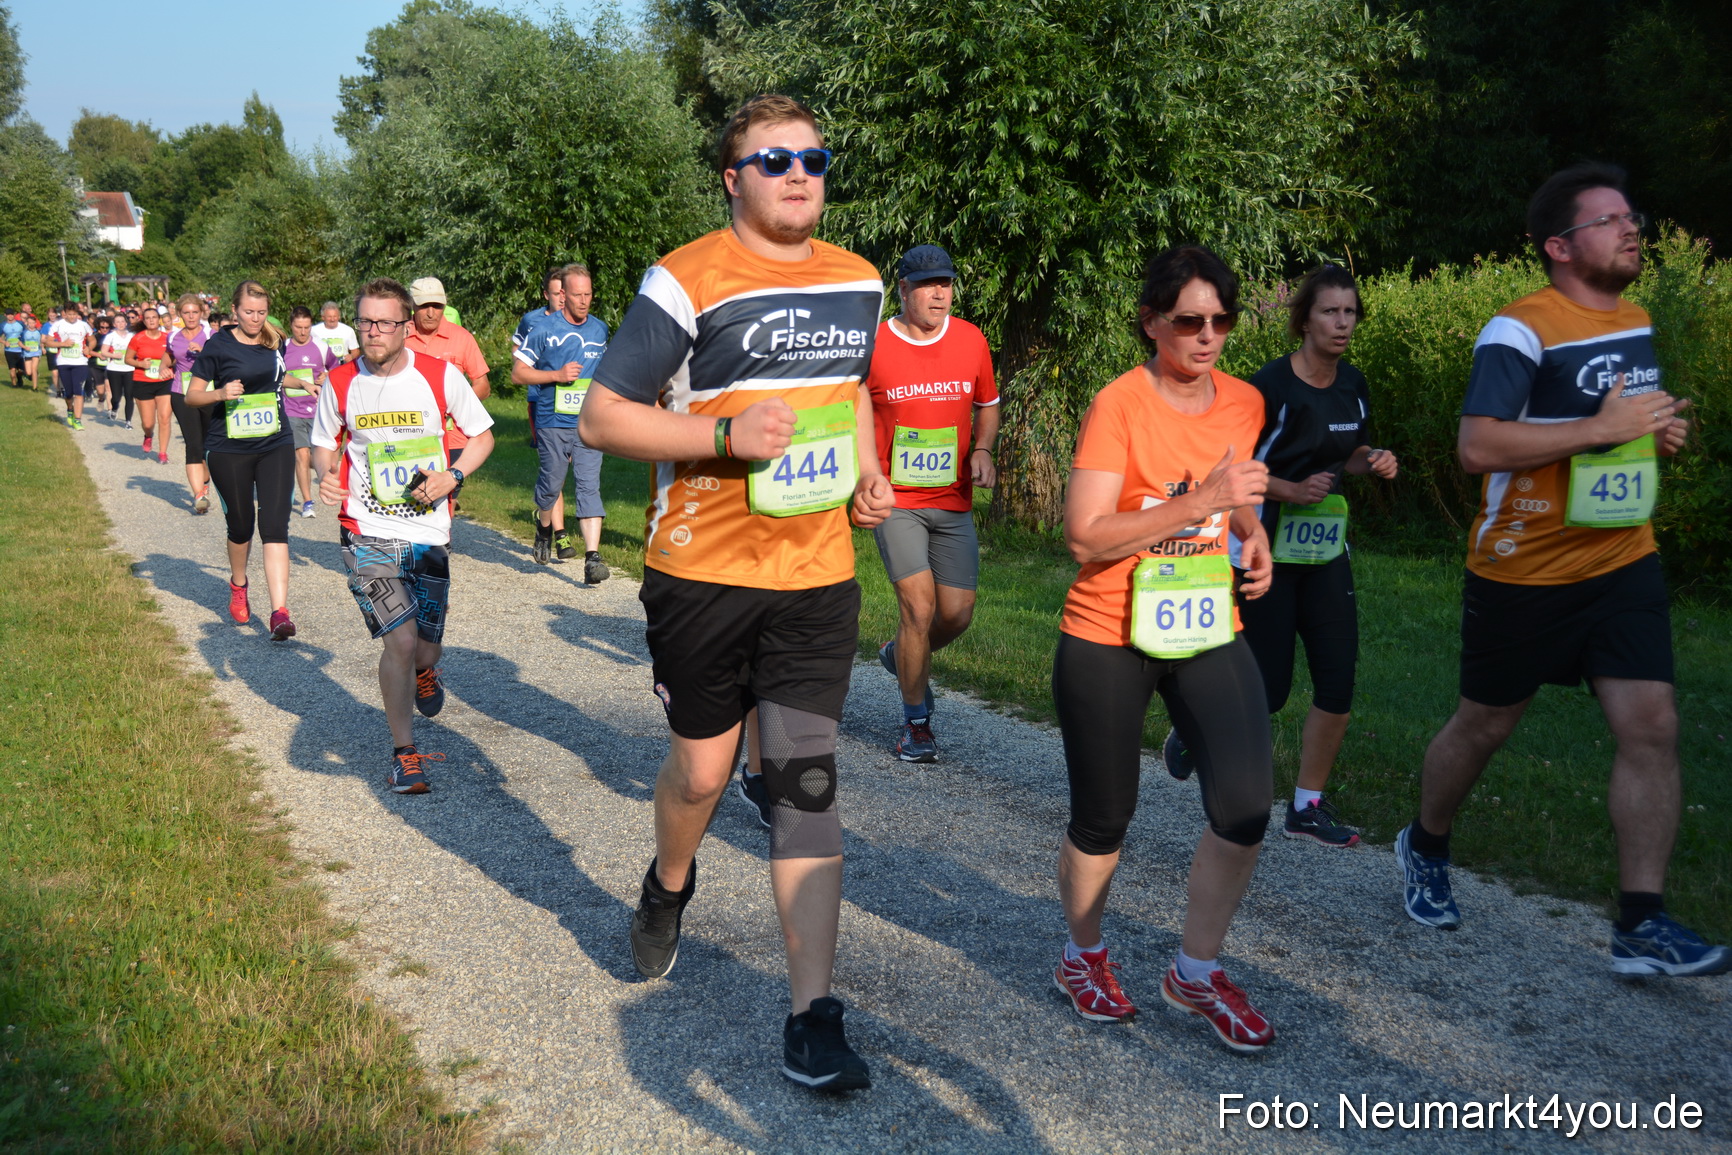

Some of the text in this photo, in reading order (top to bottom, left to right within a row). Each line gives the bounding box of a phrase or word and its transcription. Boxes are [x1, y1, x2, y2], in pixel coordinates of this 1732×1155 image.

[770, 325, 867, 351] Fischer
[777, 349, 866, 361] AUTOMOBILE
[886, 381, 960, 401] NEUMARKT
[232, 410, 273, 427] 1130
[358, 413, 418, 428] ONLINE
[773, 447, 839, 487] 444
[899, 451, 952, 471] 1402
[782, 488, 834, 501] Florian Thurner
[1589, 470, 1642, 502] 431
[1283, 521, 1339, 545] 1094
[1155, 596, 1216, 631] 618
